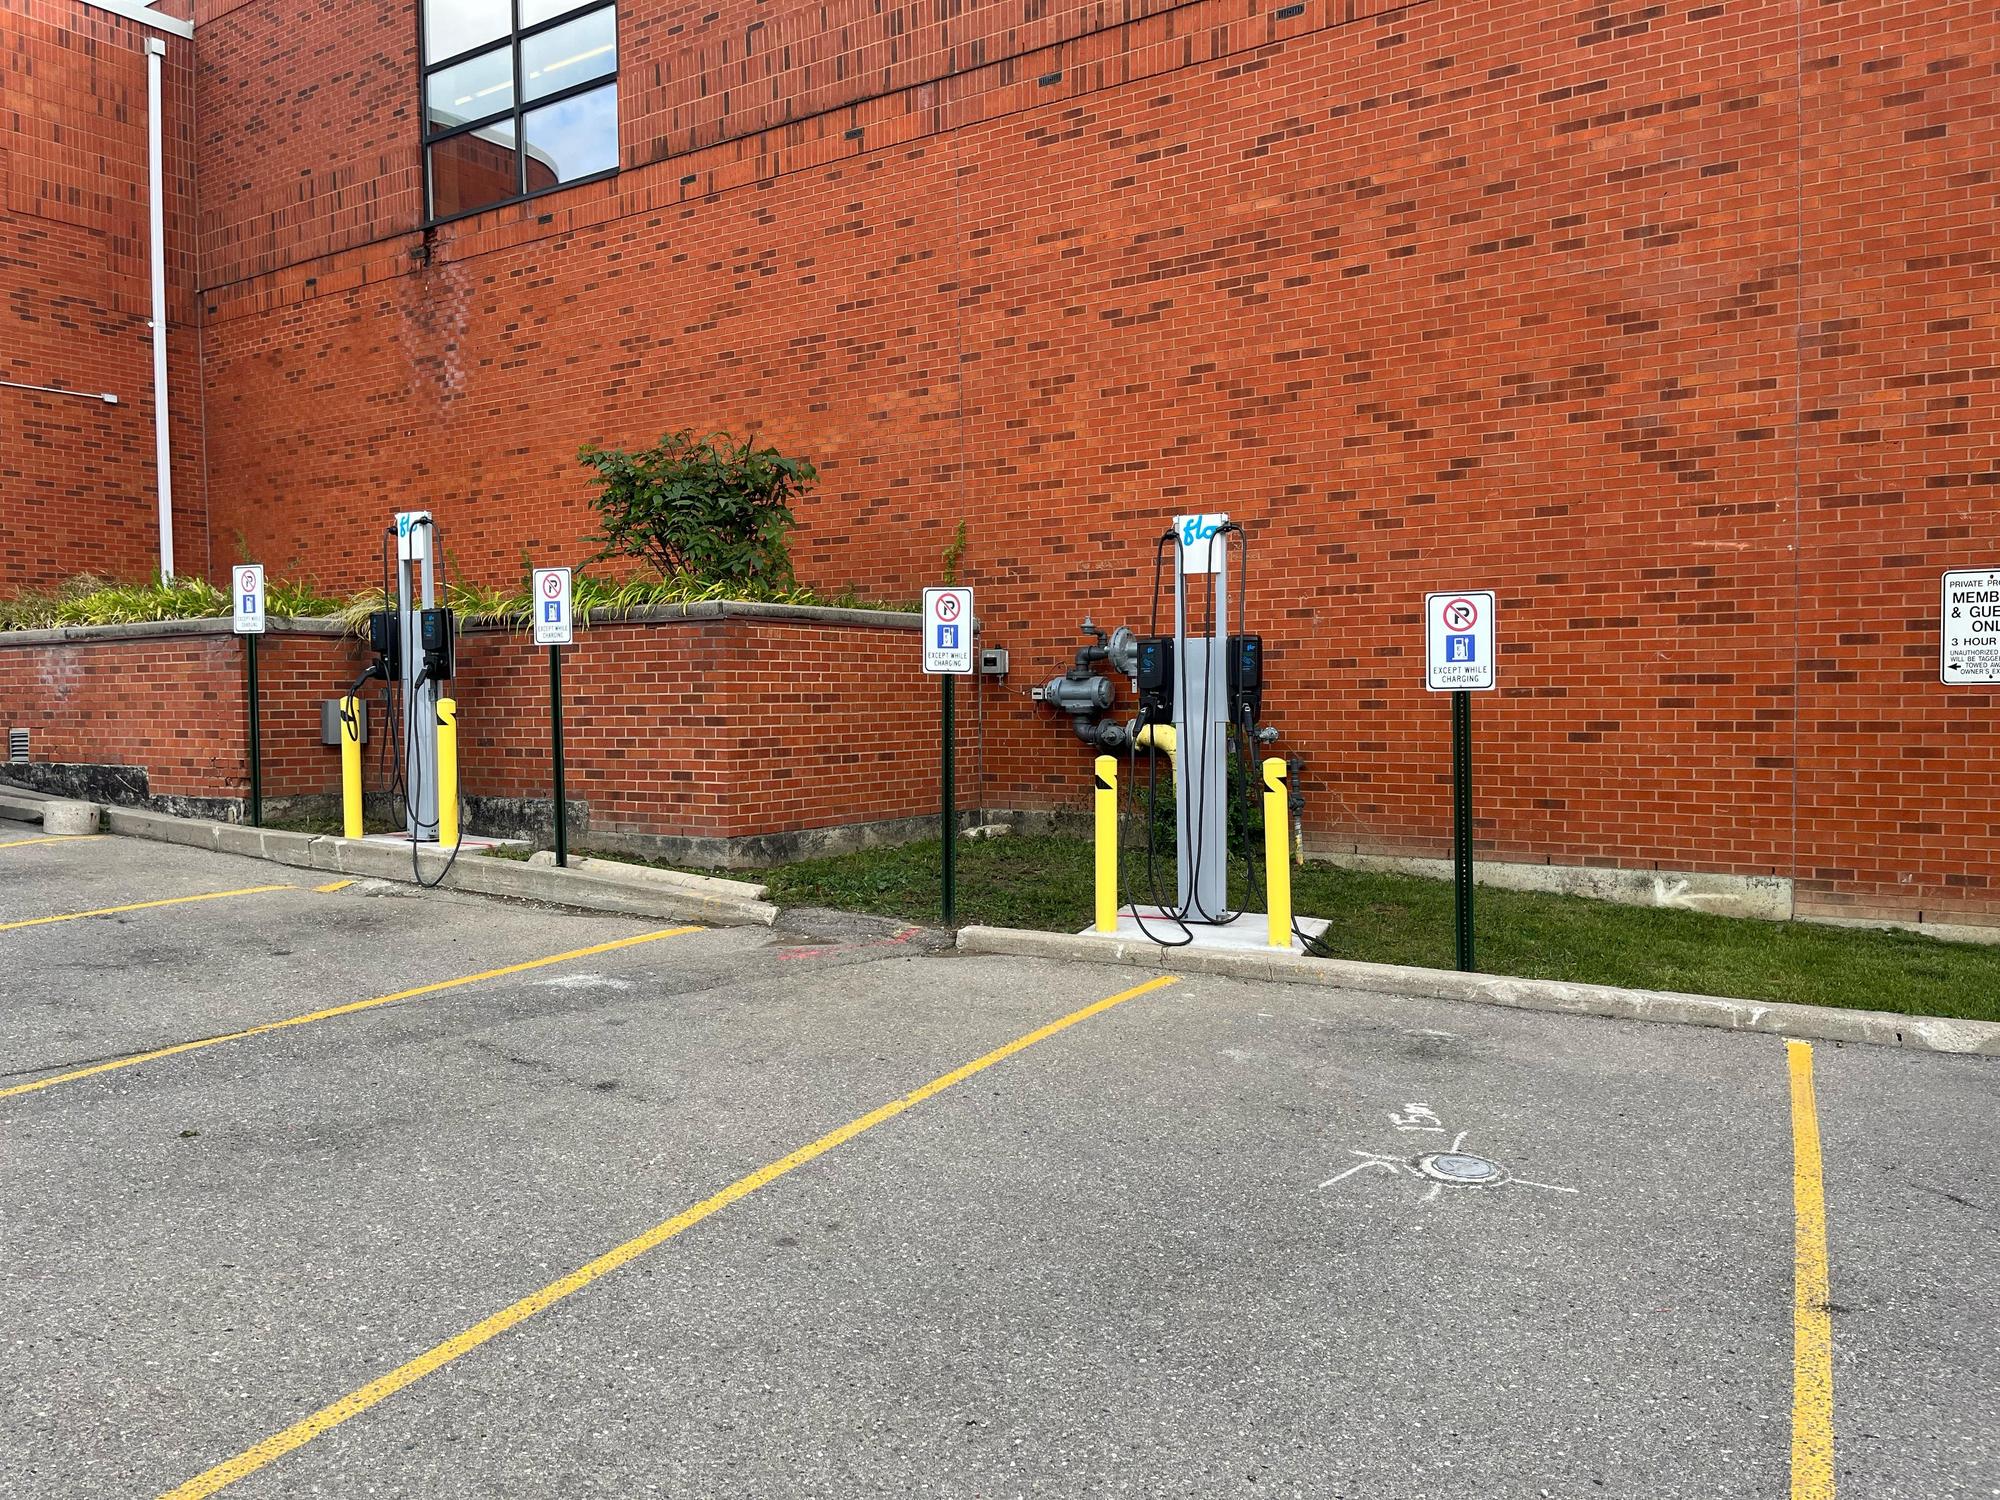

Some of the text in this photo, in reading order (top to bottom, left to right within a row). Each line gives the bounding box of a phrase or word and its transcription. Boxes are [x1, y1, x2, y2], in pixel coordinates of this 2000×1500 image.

[1183, 514, 1218, 546] flo
[1950, 580, 1983, 588] PRIVATE
[1953, 591, 1999, 603] MEMB
[1951, 607, 1961, 618] &
[1951, 637, 1997, 646] 3 HOUR
[1433, 665, 1487, 674] EXCEPT WHILE
[1441, 675, 1479, 683] CHARGING
